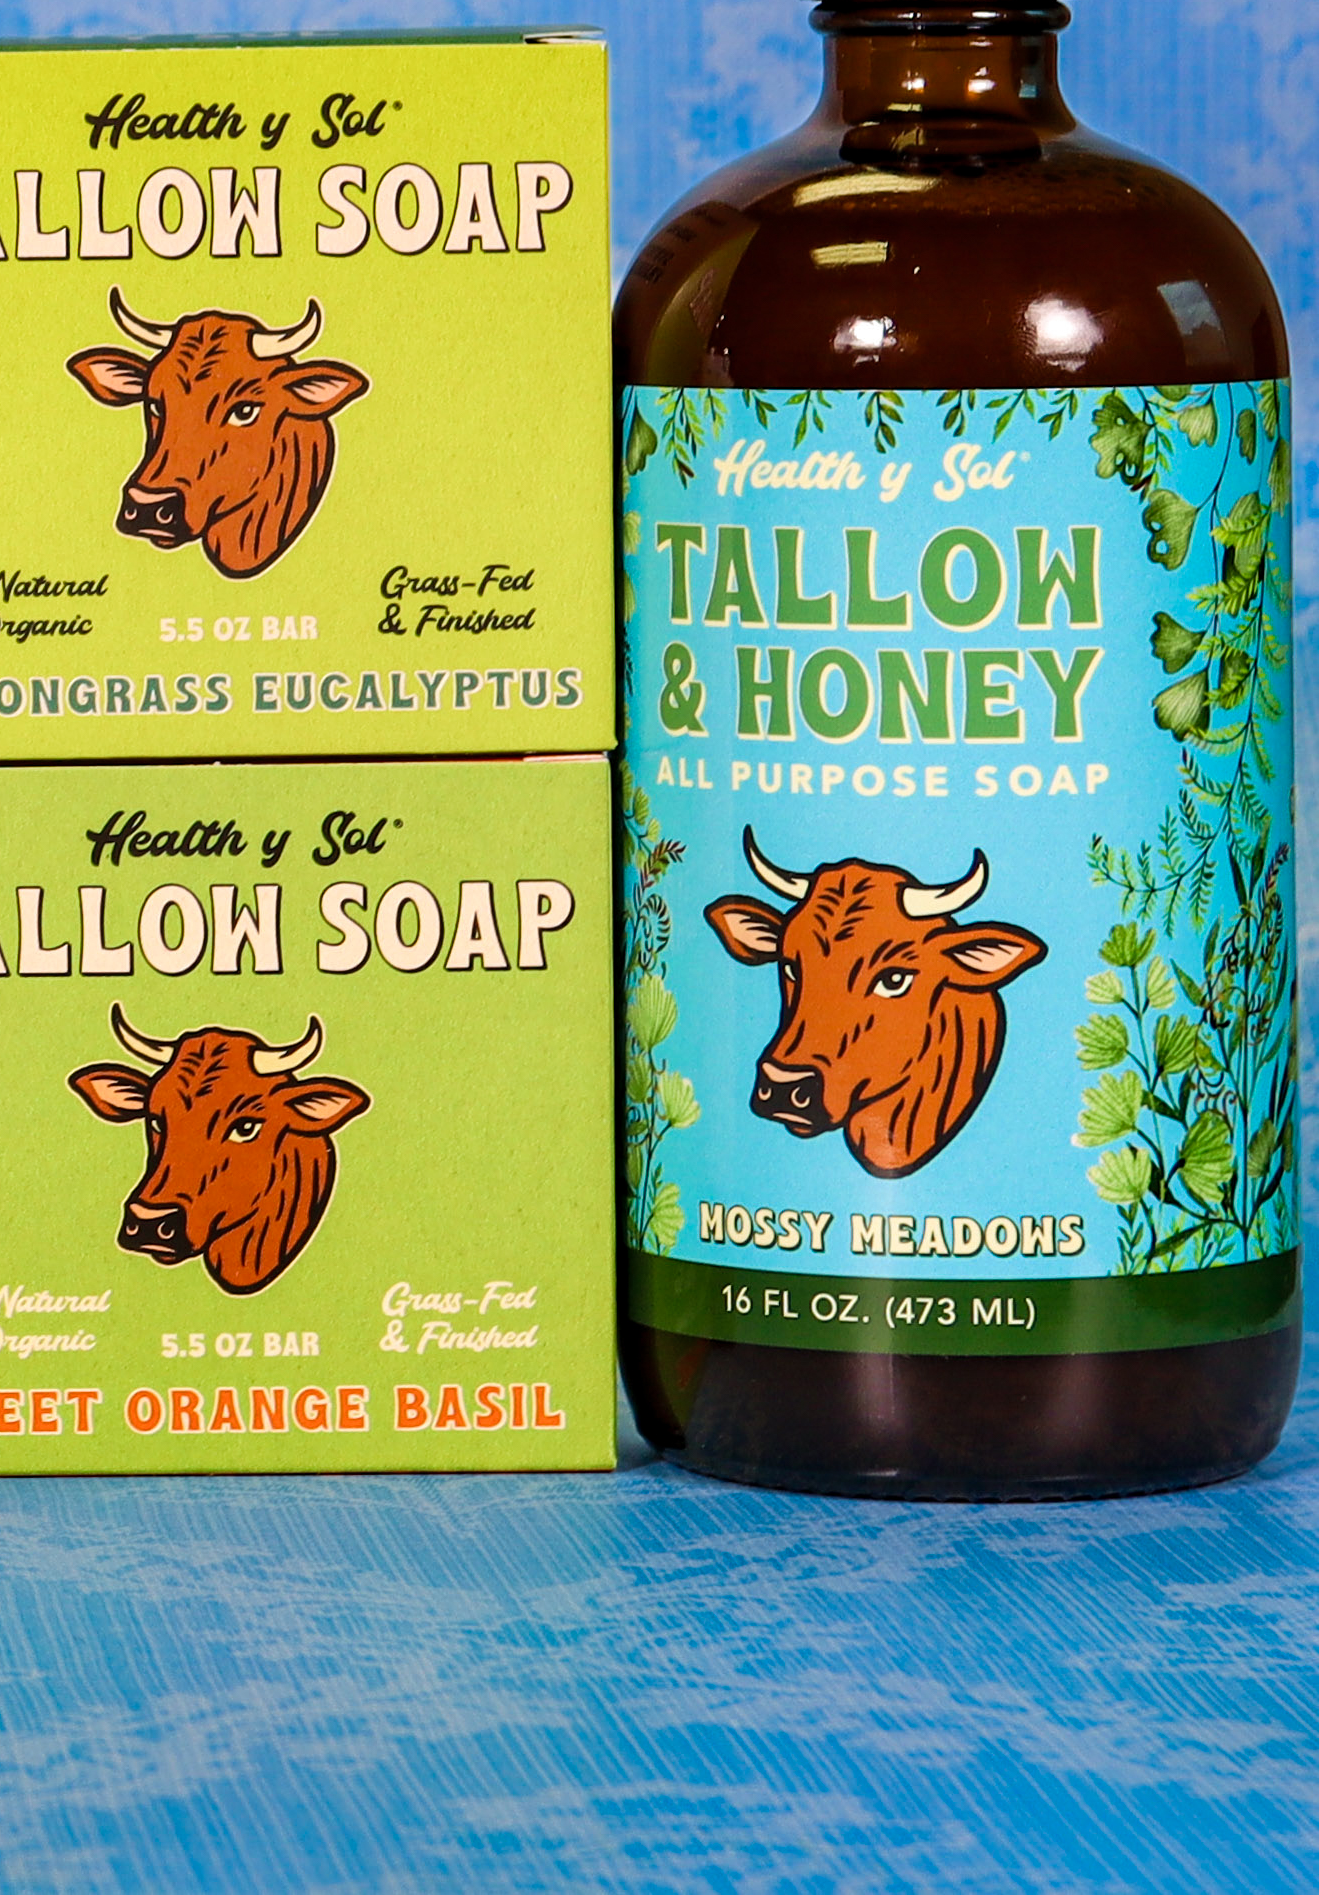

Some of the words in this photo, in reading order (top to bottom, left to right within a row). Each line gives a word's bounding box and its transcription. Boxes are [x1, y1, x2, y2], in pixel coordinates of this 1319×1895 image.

[84, 94, 246, 148] Health
[261, 111, 291, 150] y
[315, 161, 574, 256] SOAP
[714, 438, 863, 497] Health
[880, 460, 912, 503] y
[380, 565, 535, 600] Grass-Fed
[655, 522, 1102, 632] TALLOW
[160, 617, 205, 642] 5.5
[213, 617, 253, 642] OZ
[261, 616, 318, 641] BAR
[377, 605, 406, 635] &
[415, 605, 536, 634] Finished
[253, 667, 584, 716] EUCALYPTUS
[659, 642, 709, 739] &
[734, 646, 1105, 744] HONEY
[656, 756, 714, 790] ALL
[731, 761, 949, 797] PURPOSE
[975, 764, 1110, 795] SOAP
[86, 811, 247, 866] Health
[261, 828, 290, 866] y
[316, 879, 576, 972] SOAP
[699, 1202, 834, 1252] MOSSY
[850, 1212, 1086, 1257] MEADOWS
[382, 1282, 537, 1318] Grass-Fed
[722, 1285, 751, 1313] 16
[764, 1289, 799, 1319] FL
[811, 1293, 870, 1323] OZ.
[885, 1295, 956, 1328] (473
[972, 1297, 1036, 1329] ML)
[162, 1333, 206, 1358] 5.5
[215, 1333, 254, 1358] OZ
[263, 1332, 320, 1357] BAR
[379, 1323, 409, 1353] &
[417, 1322, 538, 1354] Finished
[125, 1387, 369, 1433] ORANGE
[394, 1384, 565, 1431] BASIL
